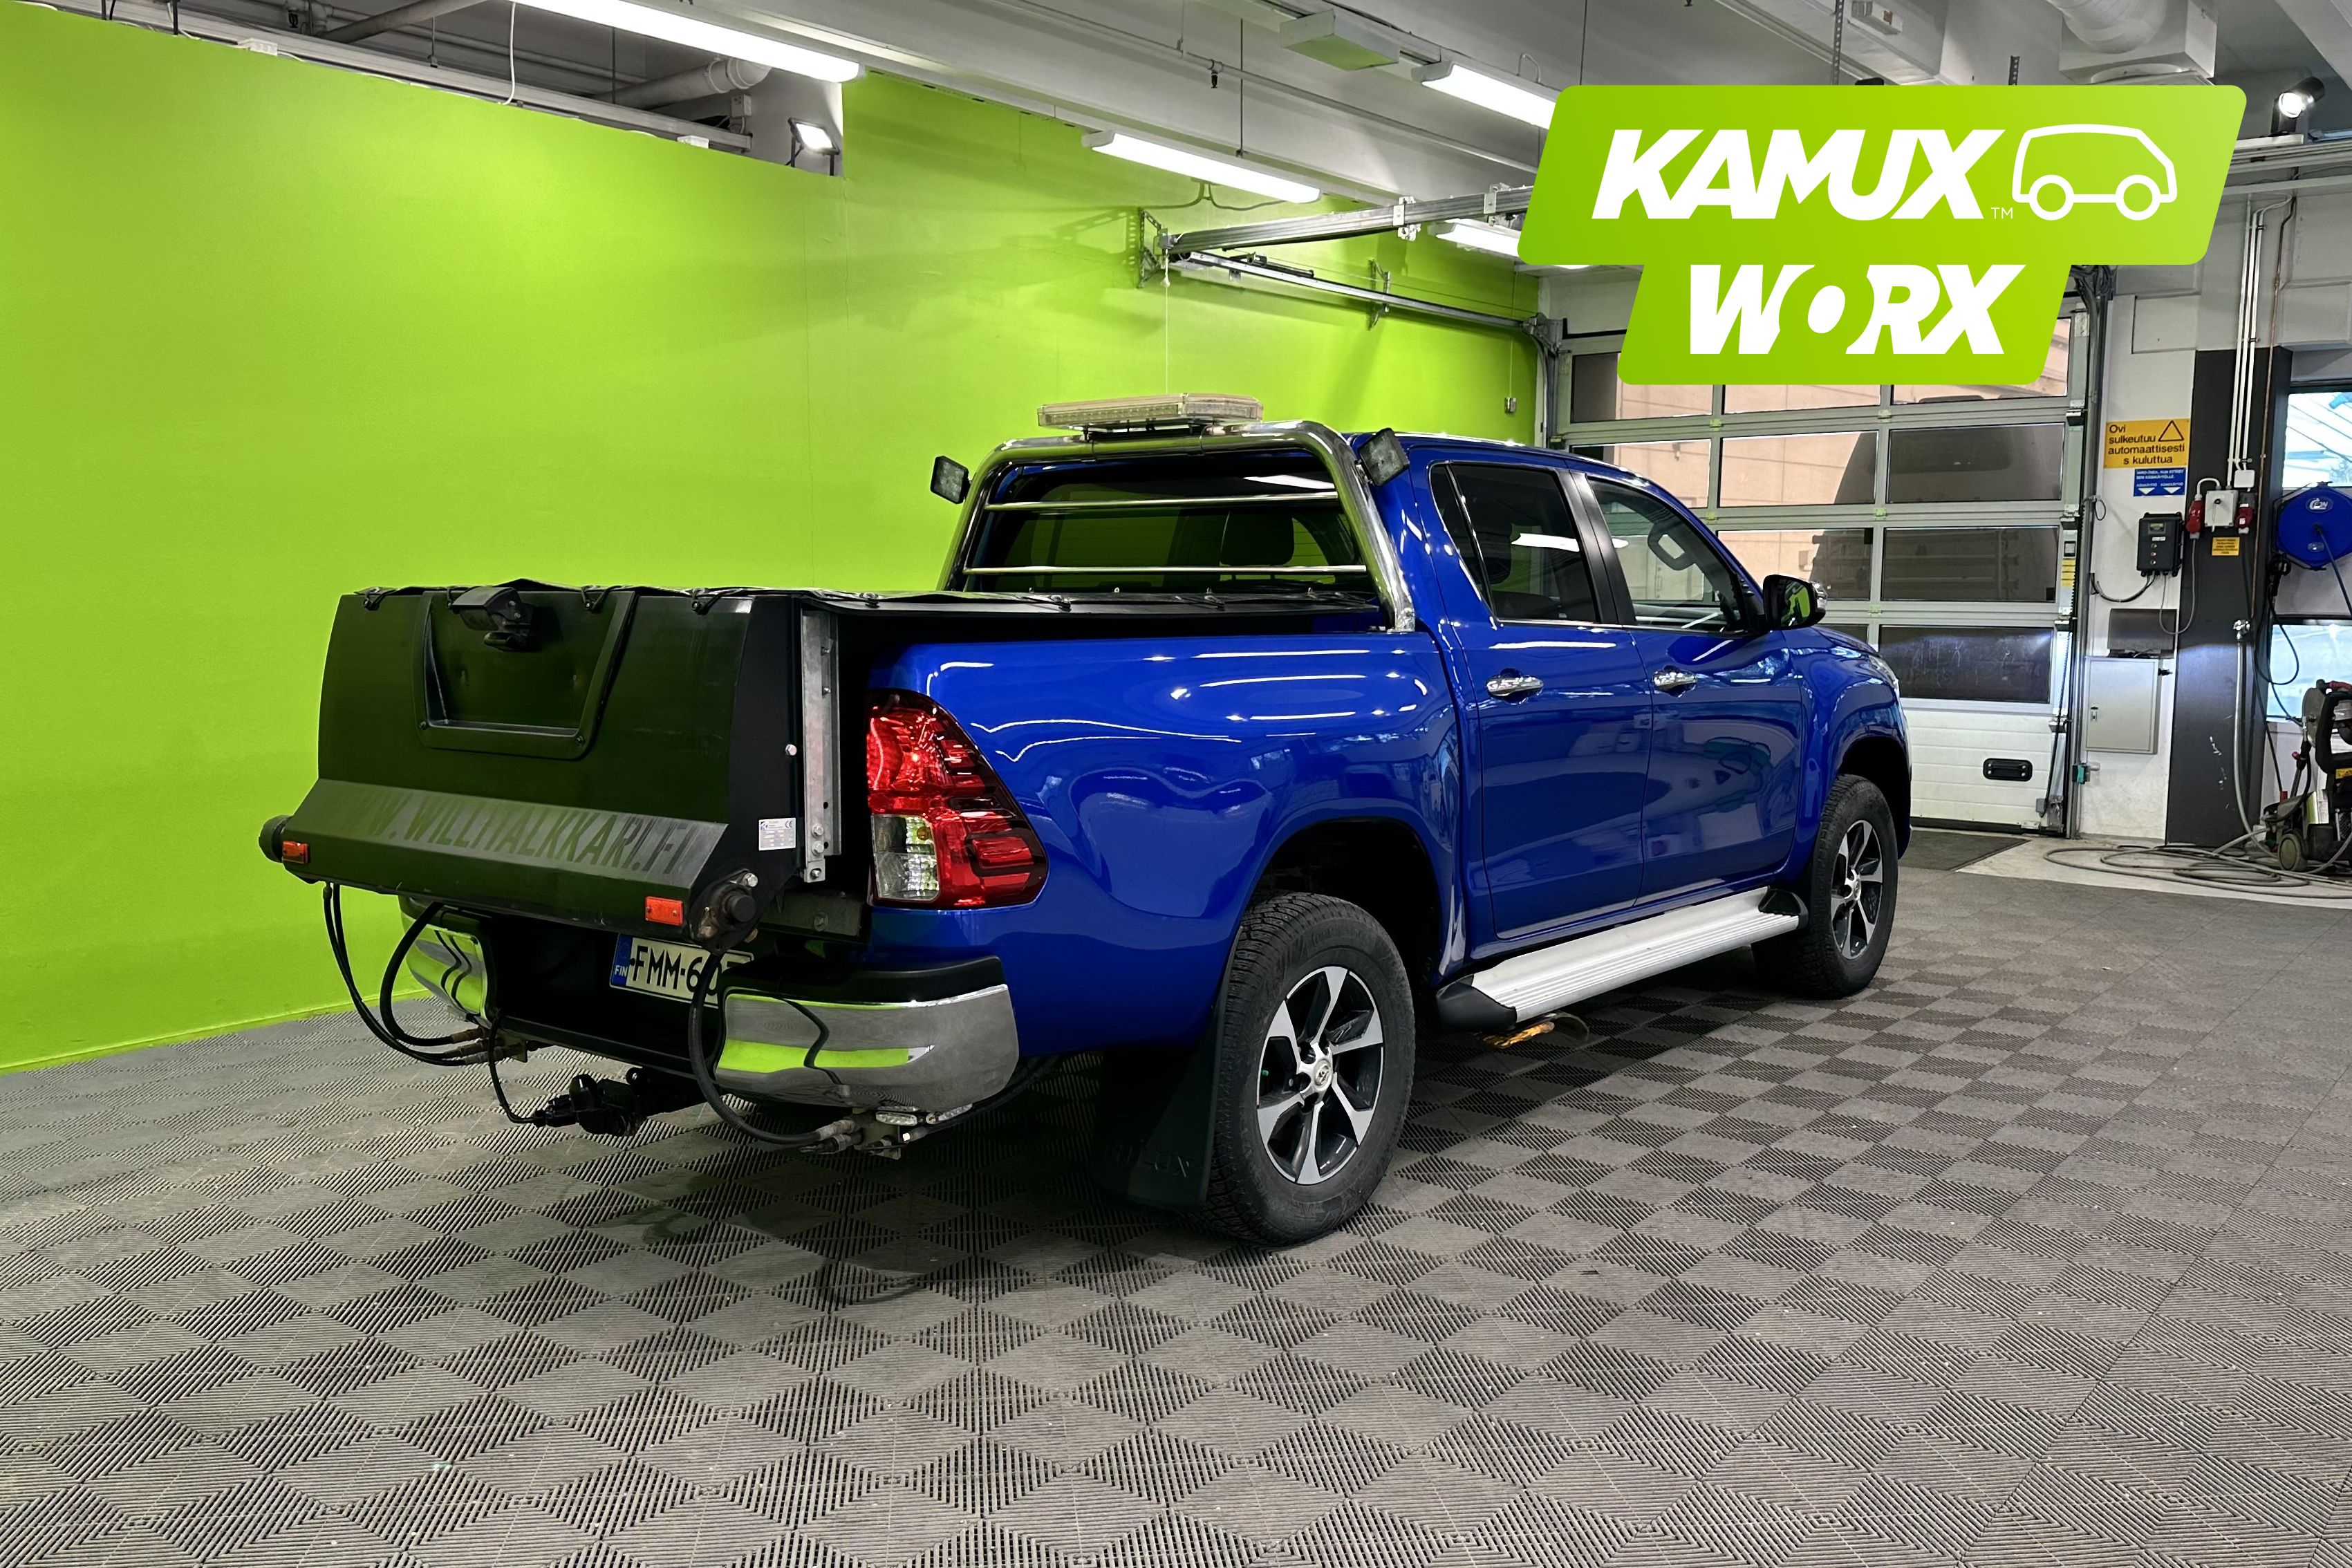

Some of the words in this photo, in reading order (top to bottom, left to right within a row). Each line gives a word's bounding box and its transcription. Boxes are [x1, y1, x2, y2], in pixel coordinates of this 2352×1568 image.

[2109, 424, 2126, 433] Ovi
[2109, 435, 2156, 444] sulkeutuu
[2108, 444, 2185, 454] automaattisesti
[2132, 456, 2173, 464] kuluttua
[614, 964, 628, 978] FIN
